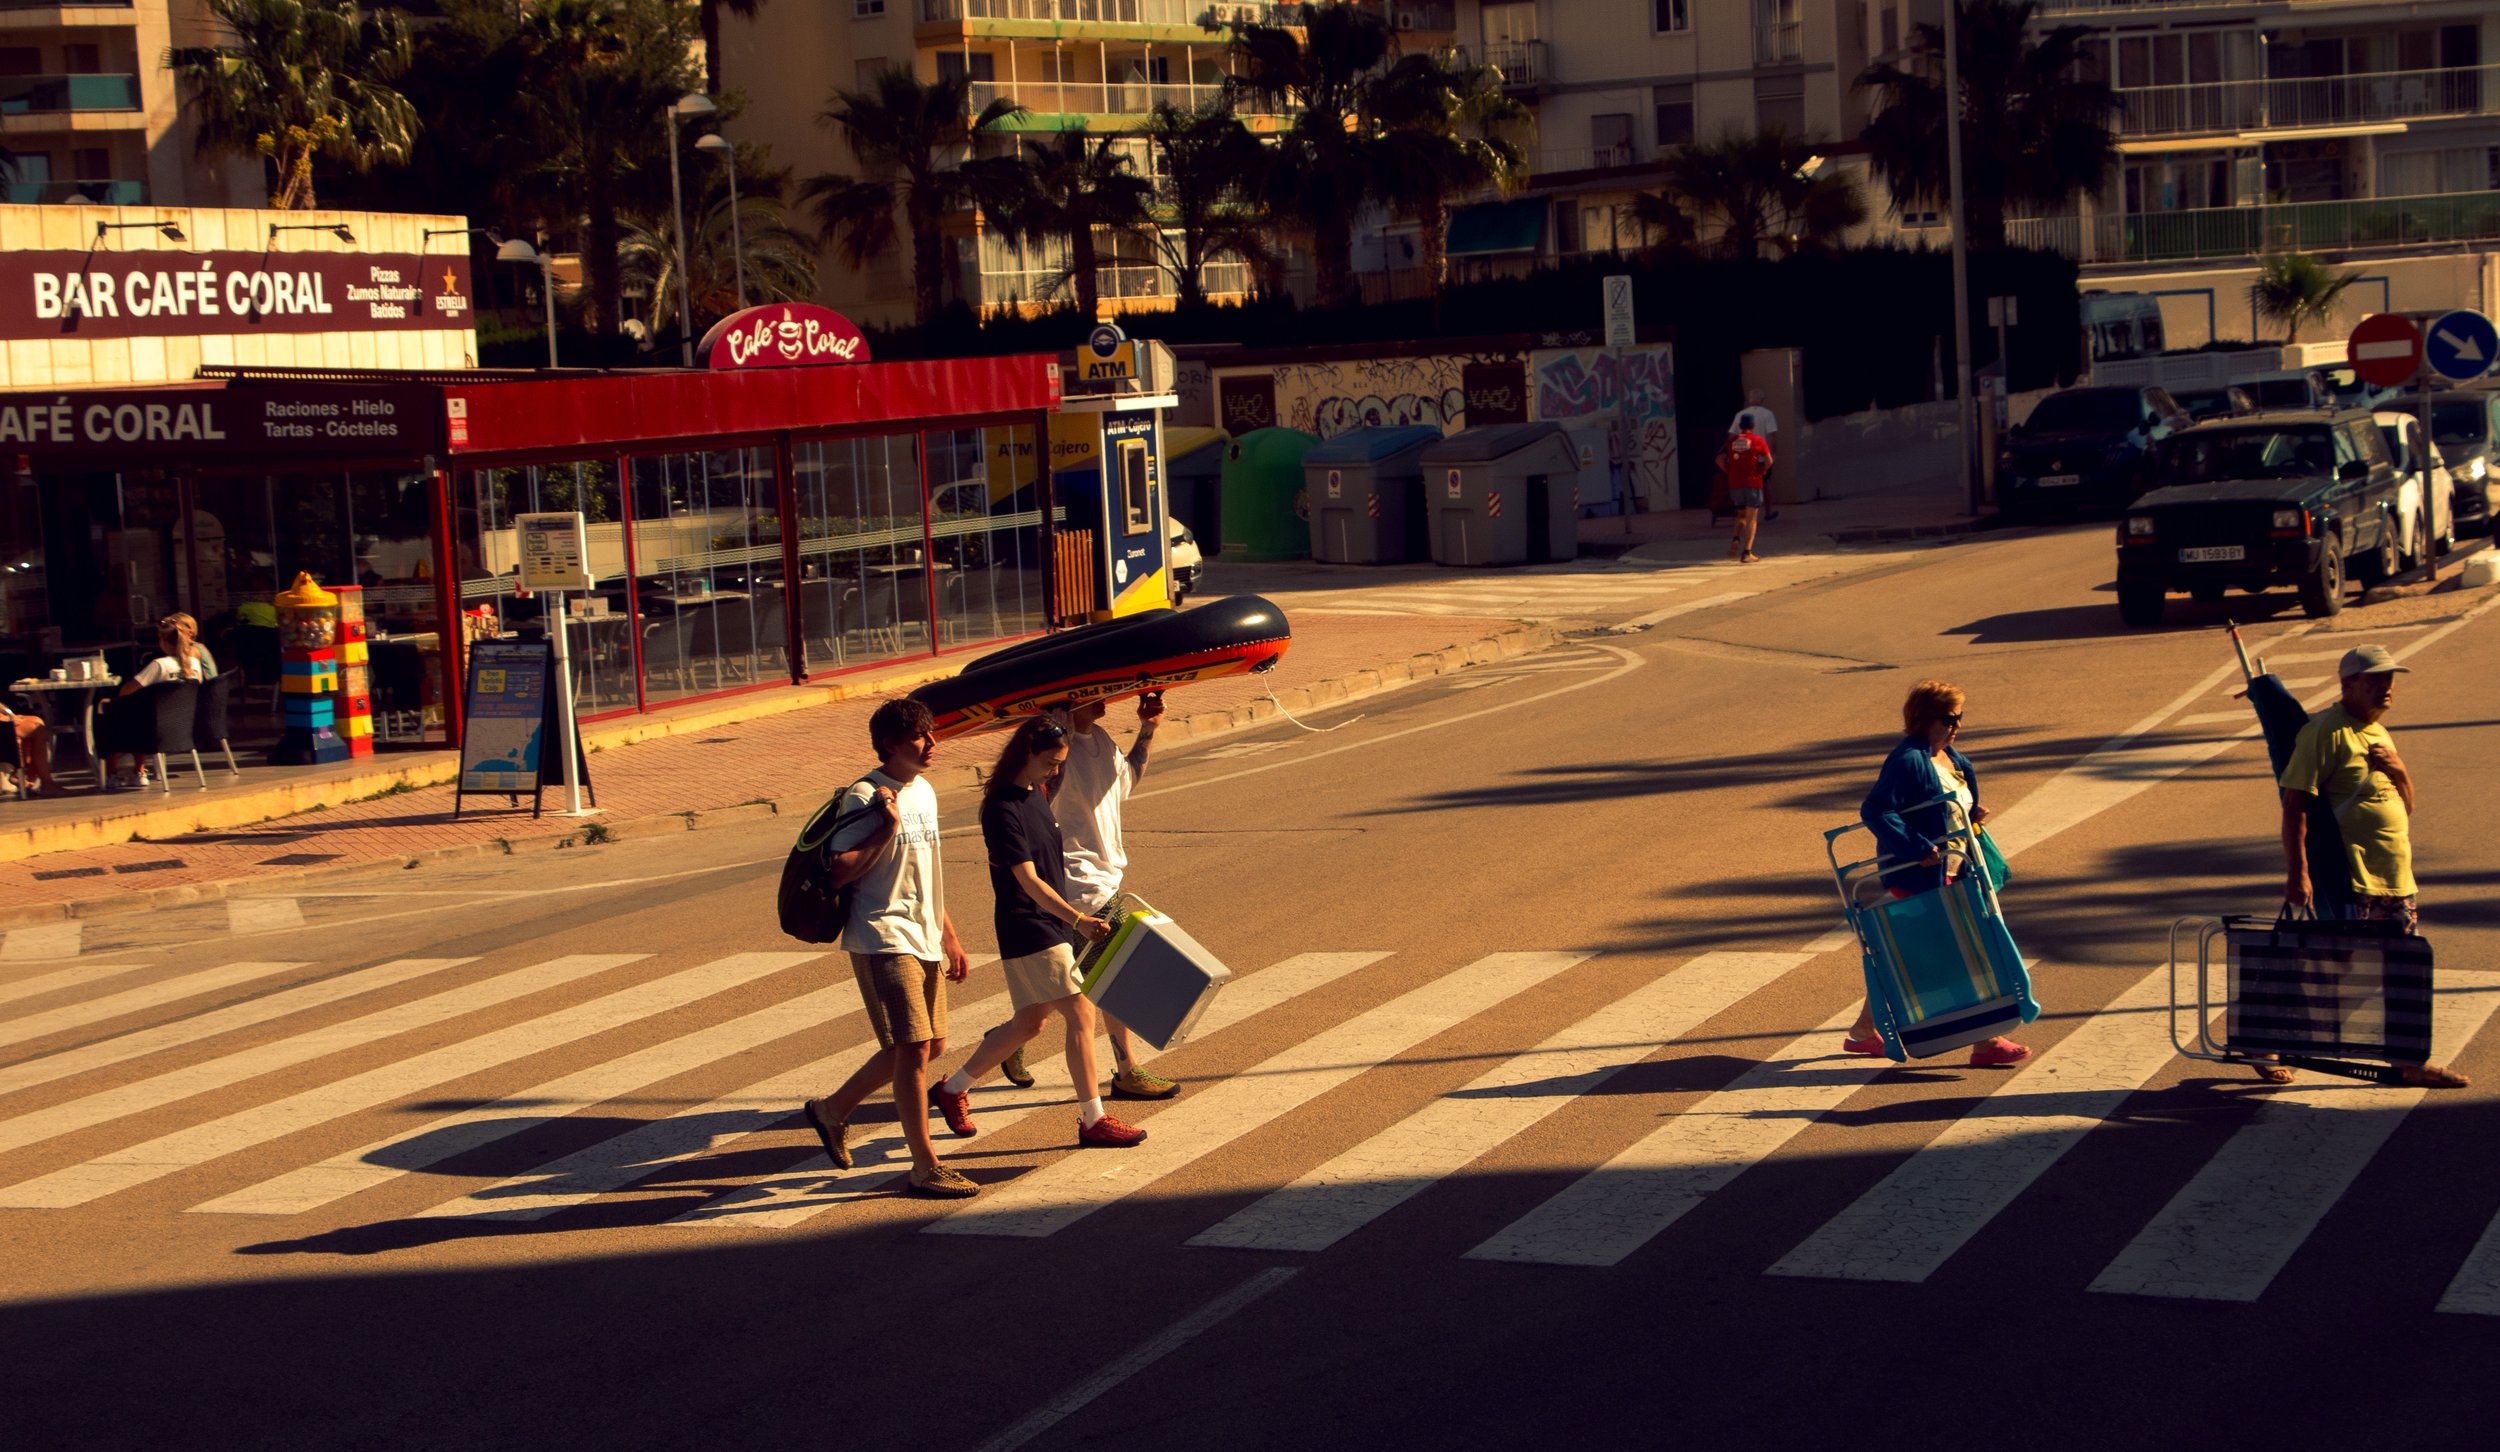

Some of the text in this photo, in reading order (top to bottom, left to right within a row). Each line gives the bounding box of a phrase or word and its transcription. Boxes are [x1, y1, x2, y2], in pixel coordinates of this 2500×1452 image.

[370, 266, 400, 283] Pizzas
[33, 260, 332, 319] BAR CAFÉ CORAL
[346, 284, 423, 301] Zumos Naturales
[370, 302, 406, 319] Batidos
[435, 296, 468, 310] ESTRELLA
[726, 318, 860, 365] Café Coral
[1088, 360, 1127, 379] ATM
[265, 401, 339, 417] Raciones
[352, 400, 394, 416] Hielo
[83, 403, 226, 442] CORAL
[263, 421, 314, 438] Tartas
[325, 419, 398, 438] Cócteles
[998, 442, 1032, 456] ATM
[1067, 685, 1097, 700] PRO
[1018, 700, 1038, 712] 100
[902, 811, 933, 826] stone
